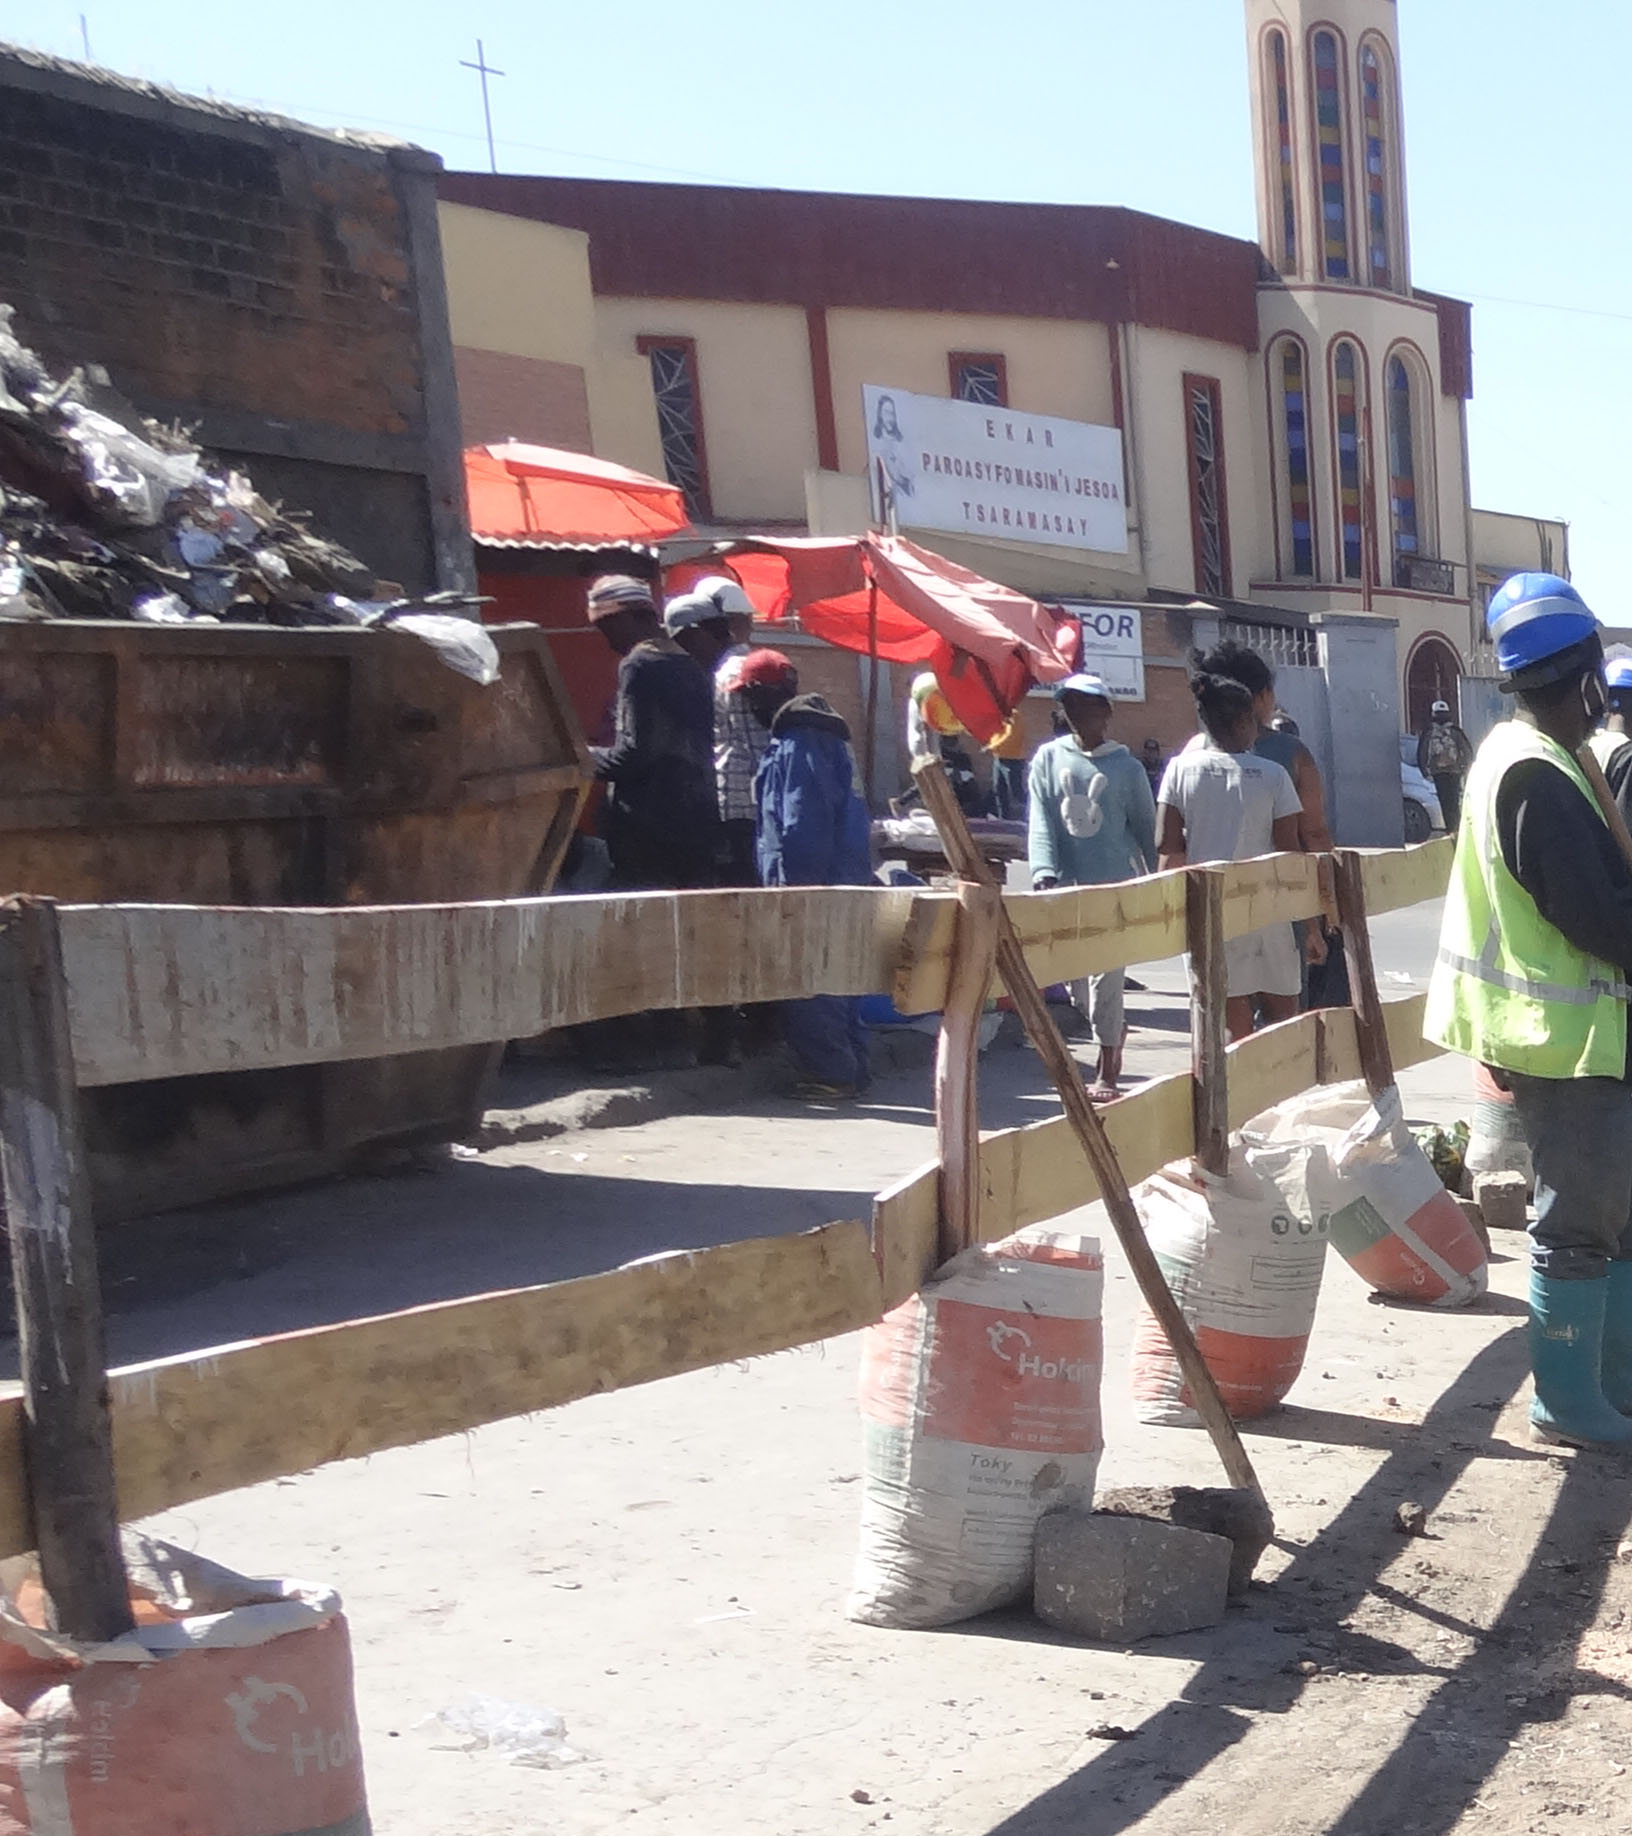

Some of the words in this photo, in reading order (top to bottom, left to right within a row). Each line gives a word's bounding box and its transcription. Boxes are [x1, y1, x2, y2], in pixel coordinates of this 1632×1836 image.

[1074, 477, 1120, 500] JESOA
[963, 501, 1088, 536] TSARAMASAY
[970, 1453, 1013, 1474] Toky
